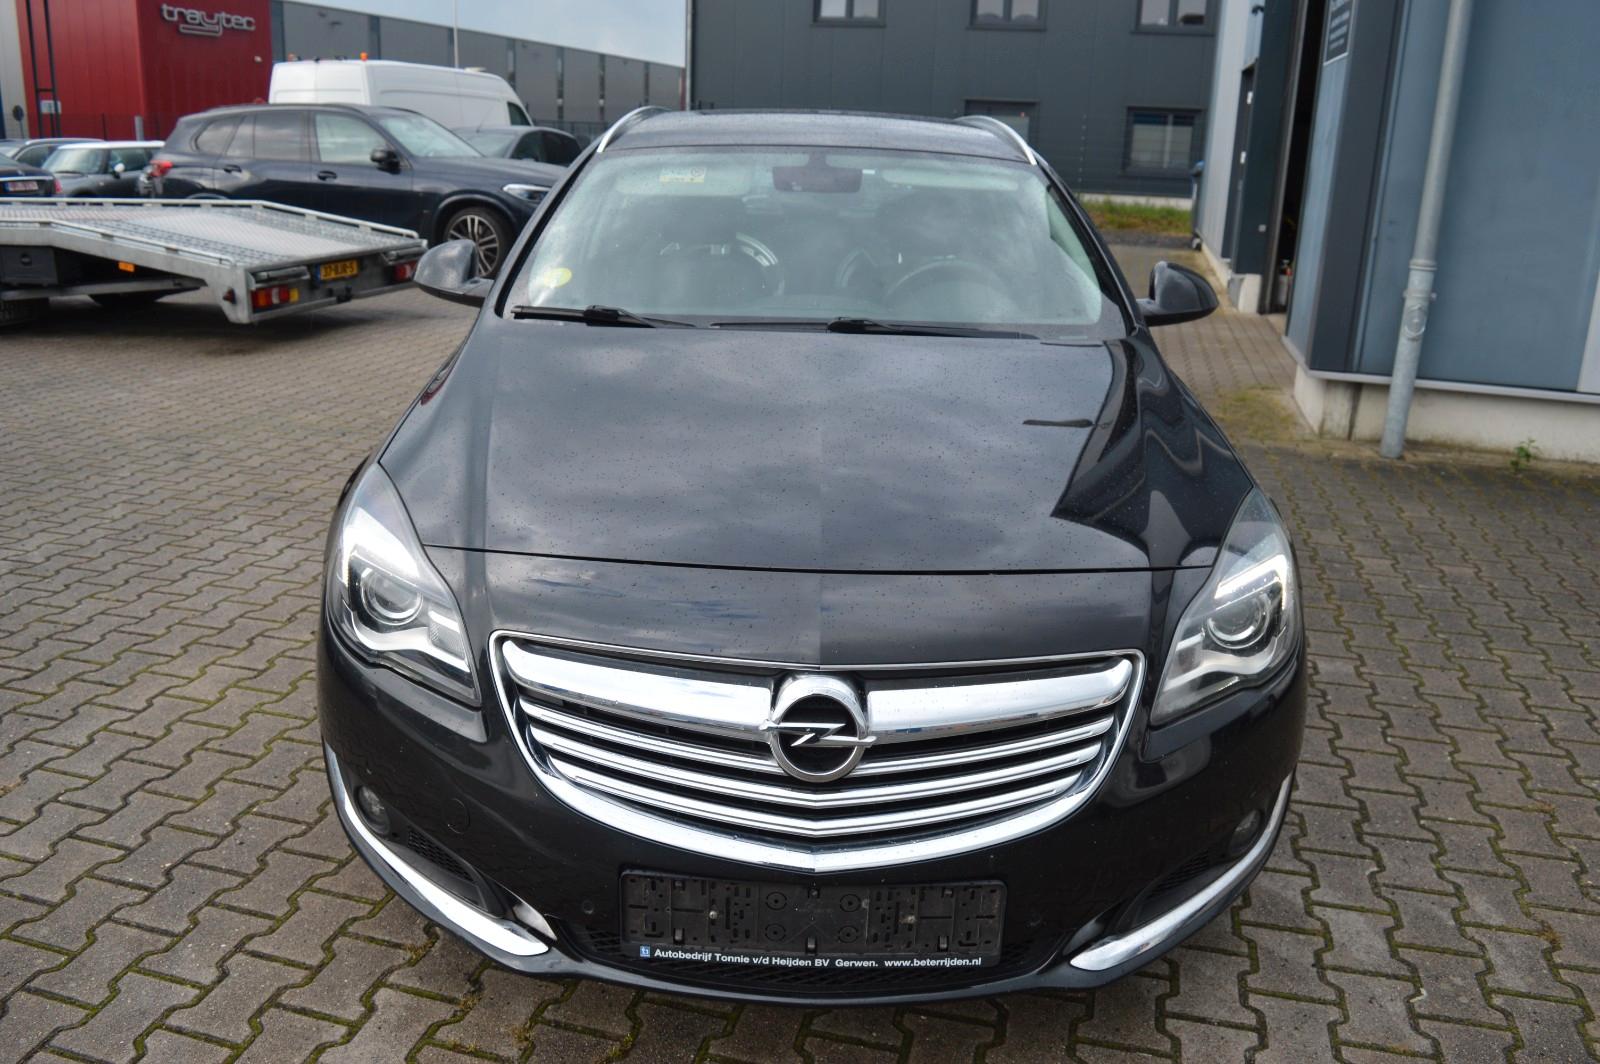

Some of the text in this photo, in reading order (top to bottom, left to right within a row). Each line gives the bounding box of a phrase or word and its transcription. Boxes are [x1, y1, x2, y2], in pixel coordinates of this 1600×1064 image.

[161, 3, 256, 37] traytec
[654, 948, 712, 962] Autobedrijf
[714, 953, 750, 964] Tonnie
[752, 956, 770, 965] v/d
[772, 957, 812, 968] Heijden
[814, 959, 830, 967] BV
[835, 959, 879, 968] Gerwen.
[884, 957, 982, 968] www.beterrijden.nl
